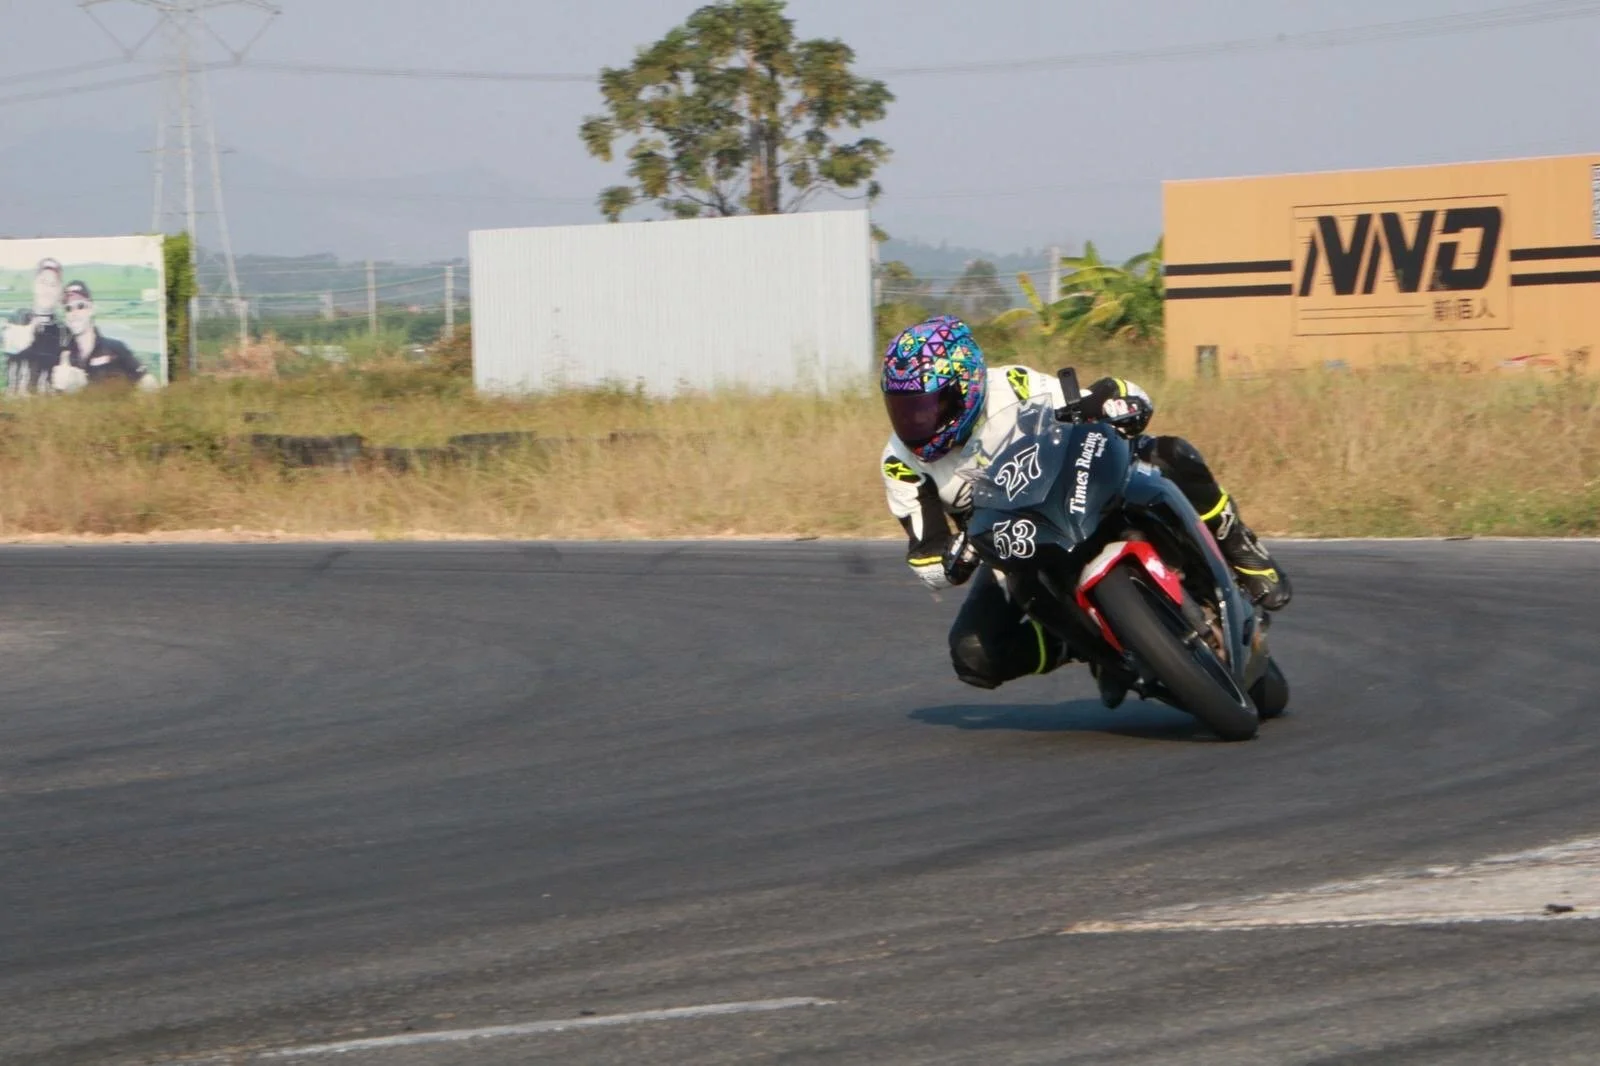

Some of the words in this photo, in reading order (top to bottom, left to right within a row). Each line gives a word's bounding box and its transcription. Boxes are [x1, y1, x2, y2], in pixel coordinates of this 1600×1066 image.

[1075, 432, 1103, 469] Racing
[994, 443, 1041, 501] 27
[1069, 470, 1089, 514] Times
[993, 520, 1036, 559] 53
